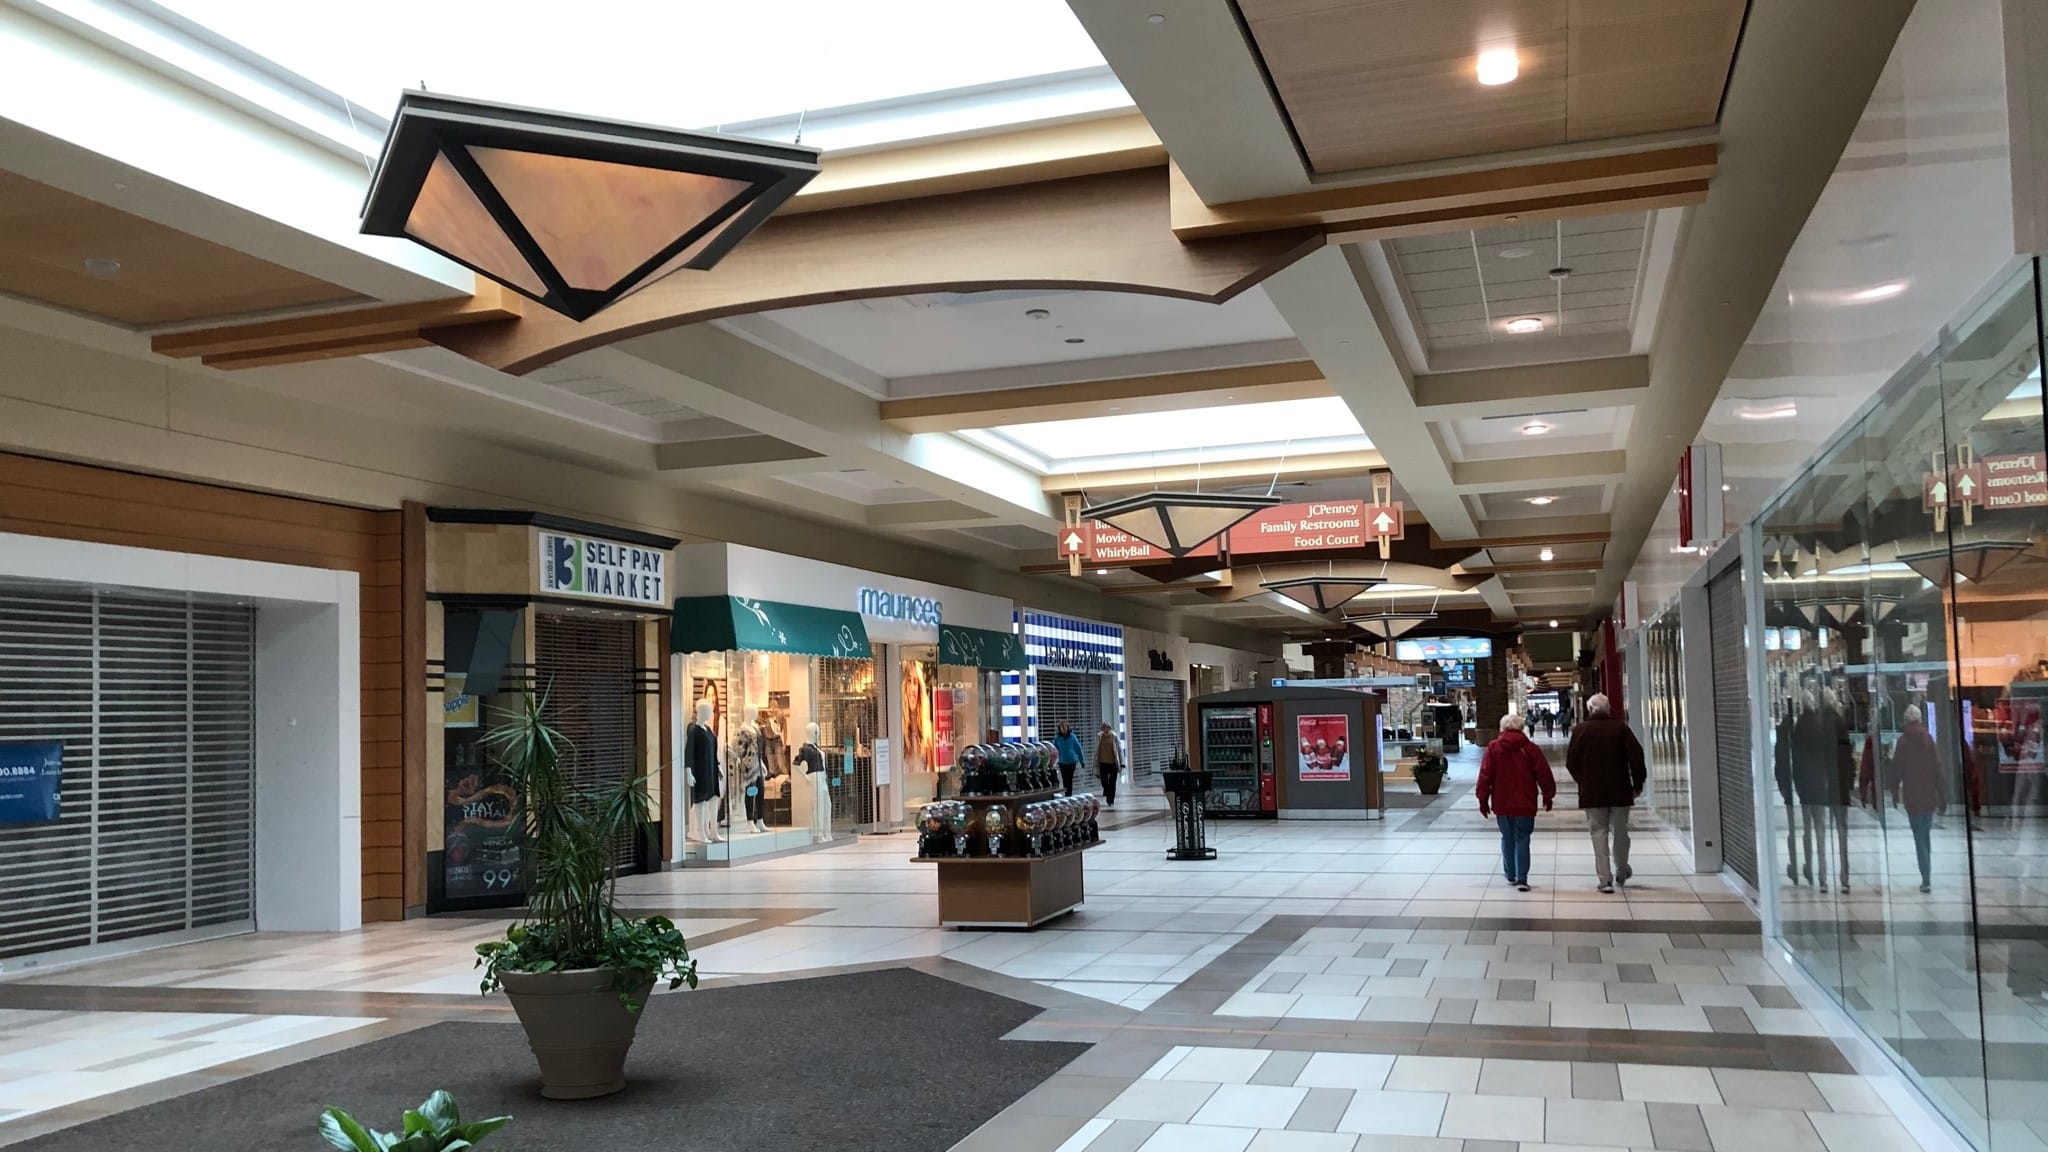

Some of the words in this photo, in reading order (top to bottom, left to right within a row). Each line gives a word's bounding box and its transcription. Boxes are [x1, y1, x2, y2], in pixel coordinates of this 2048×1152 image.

[1307, 504, 1358, 518] JCPenney
[1260, 521, 1297, 534] Family
[1300, 518, 1360, 531] Restrooms
[1096, 533, 1127, 544] Movie
[1294, 536, 1323, 547] Food
[1326, 534, 1360, 546] Court
[586, 542, 627, 568] SELF
[632, 549, 661, 573] PAY
[1096, 545, 1150, 559] WhirlyBall
[586, 567, 661, 601] MARKET
[861, 588, 943, 625] maurices
[935, 730, 954, 748] SALE
[462, 802, 495, 812] STAY
